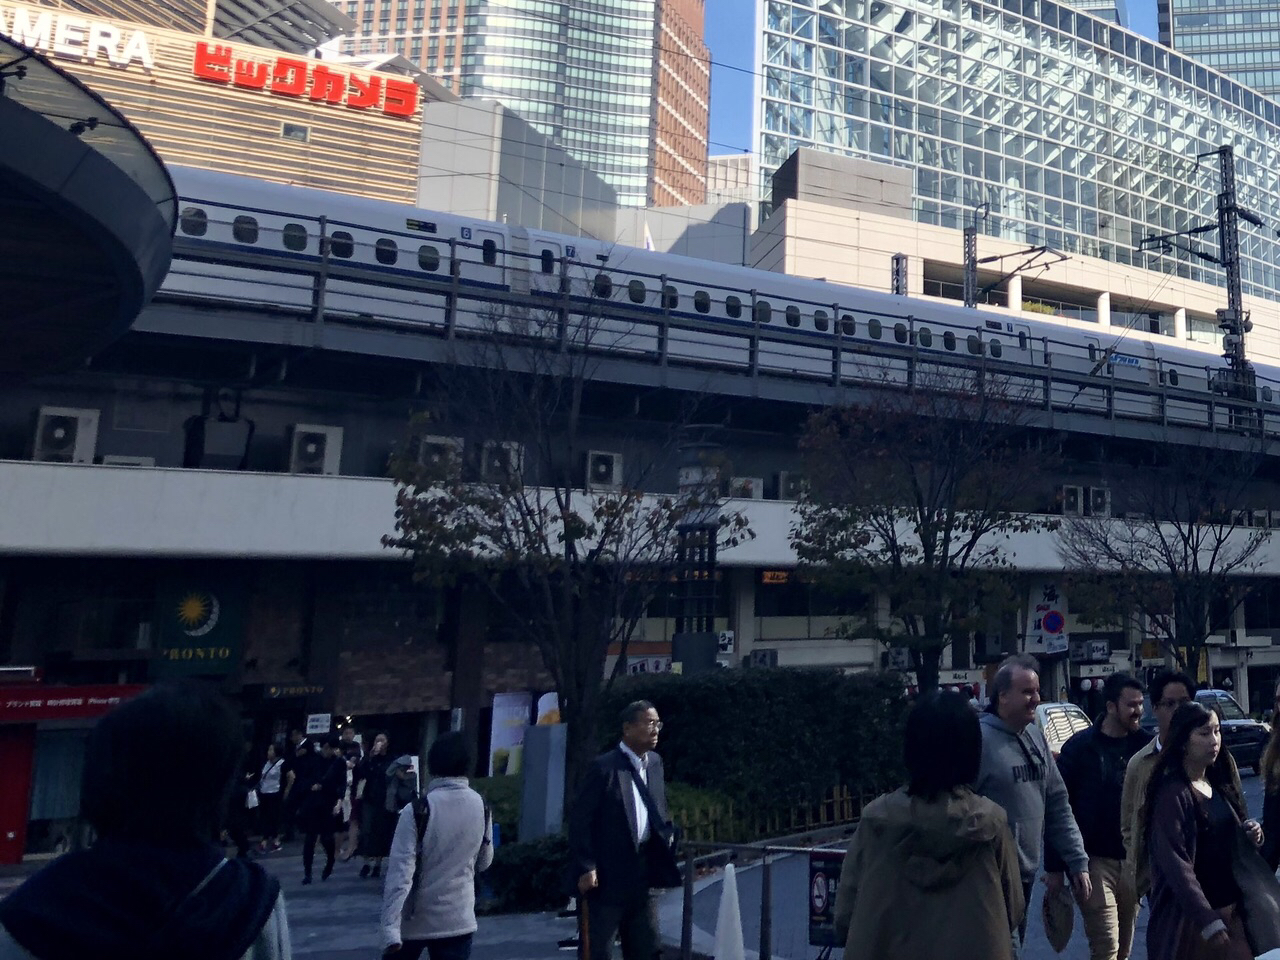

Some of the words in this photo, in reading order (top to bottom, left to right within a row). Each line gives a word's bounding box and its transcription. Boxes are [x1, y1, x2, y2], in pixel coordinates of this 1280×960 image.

[0, 5, 155, 73] MERA
[193, 39, 420, 119] ビックカメラ
